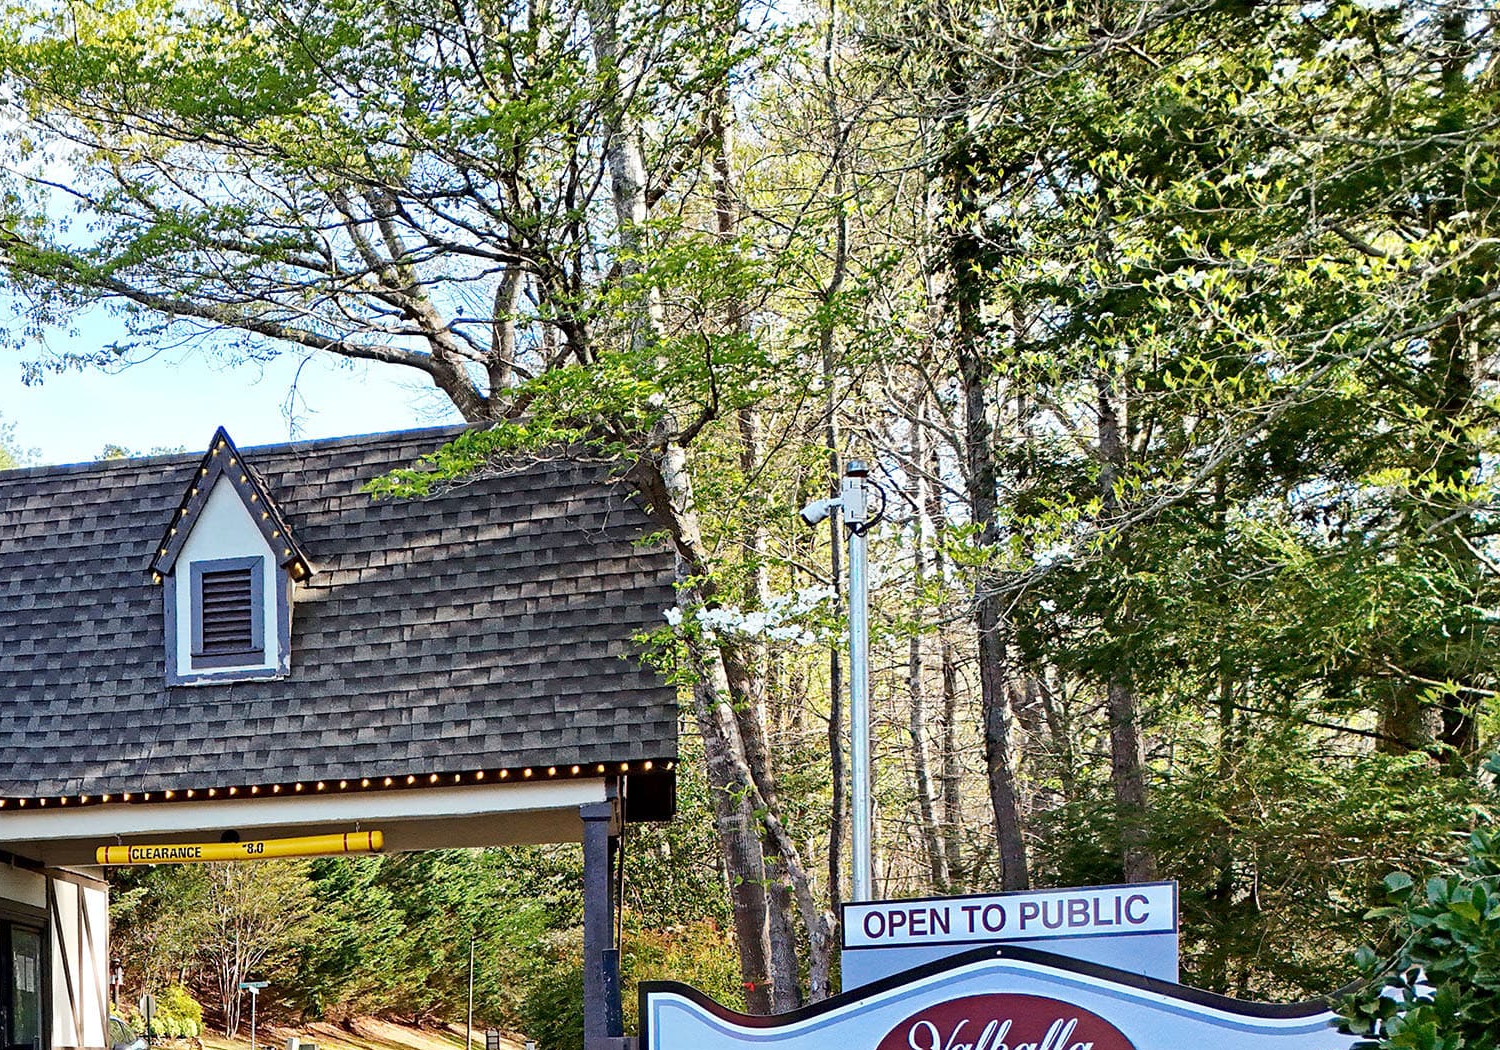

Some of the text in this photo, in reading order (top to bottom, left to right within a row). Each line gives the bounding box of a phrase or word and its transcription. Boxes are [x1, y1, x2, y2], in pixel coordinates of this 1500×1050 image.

[131, 847, 201, 860] CLEARANCE
[863, 894, 1150, 939] OPEN TO PUBLIC
